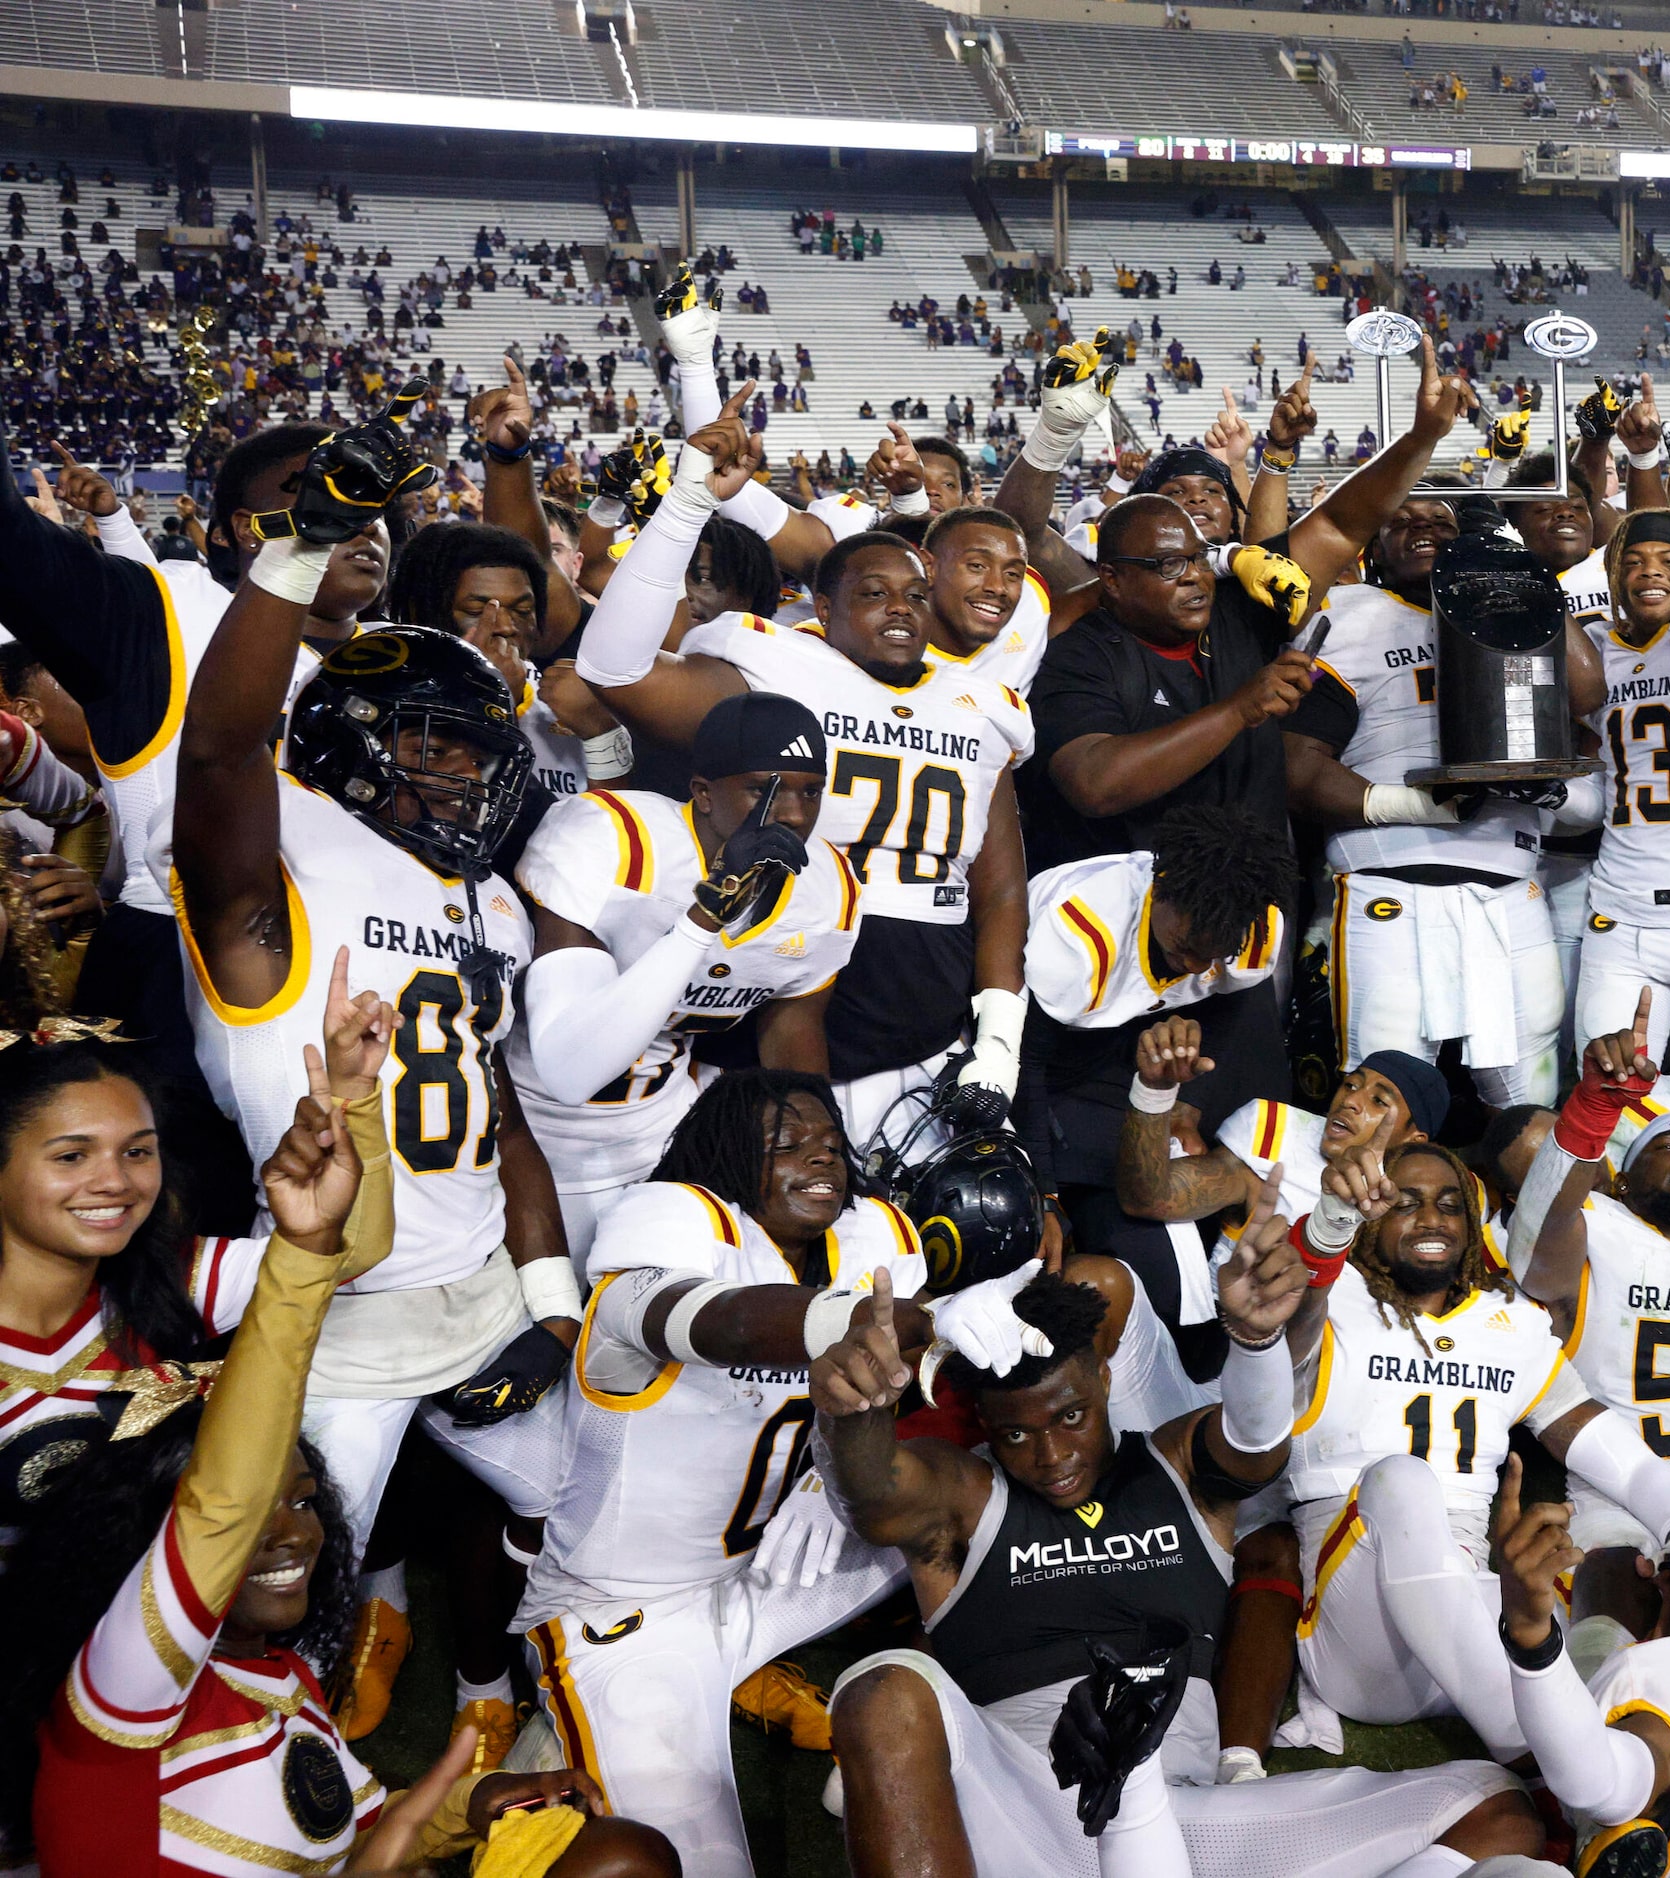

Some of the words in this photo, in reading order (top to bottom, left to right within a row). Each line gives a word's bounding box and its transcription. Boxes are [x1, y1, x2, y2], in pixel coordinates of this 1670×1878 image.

[1248, 142, 1291, 161] 0:00
[1567, 592, 1609, 614] BLIN
[823, 711, 981, 763] GRAMBLING
[538, 767, 578, 794] ING
[828, 747, 967, 885] 70
[363, 915, 518, 986] GRAMBNG
[678, 982, 775, 1009] MBLING
[1367, 1354, 1516, 1394] GRAMBLING
[1402, 1391, 1479, 1475] 11
[1009, 1524, 1181, 1574] McLLOYD
[1009, 1564, 1098, 1588] ACCURATE
[1100, 1562, 1123, 1575] OR
[1126, 1553, 1184, 1572] NOTHING
